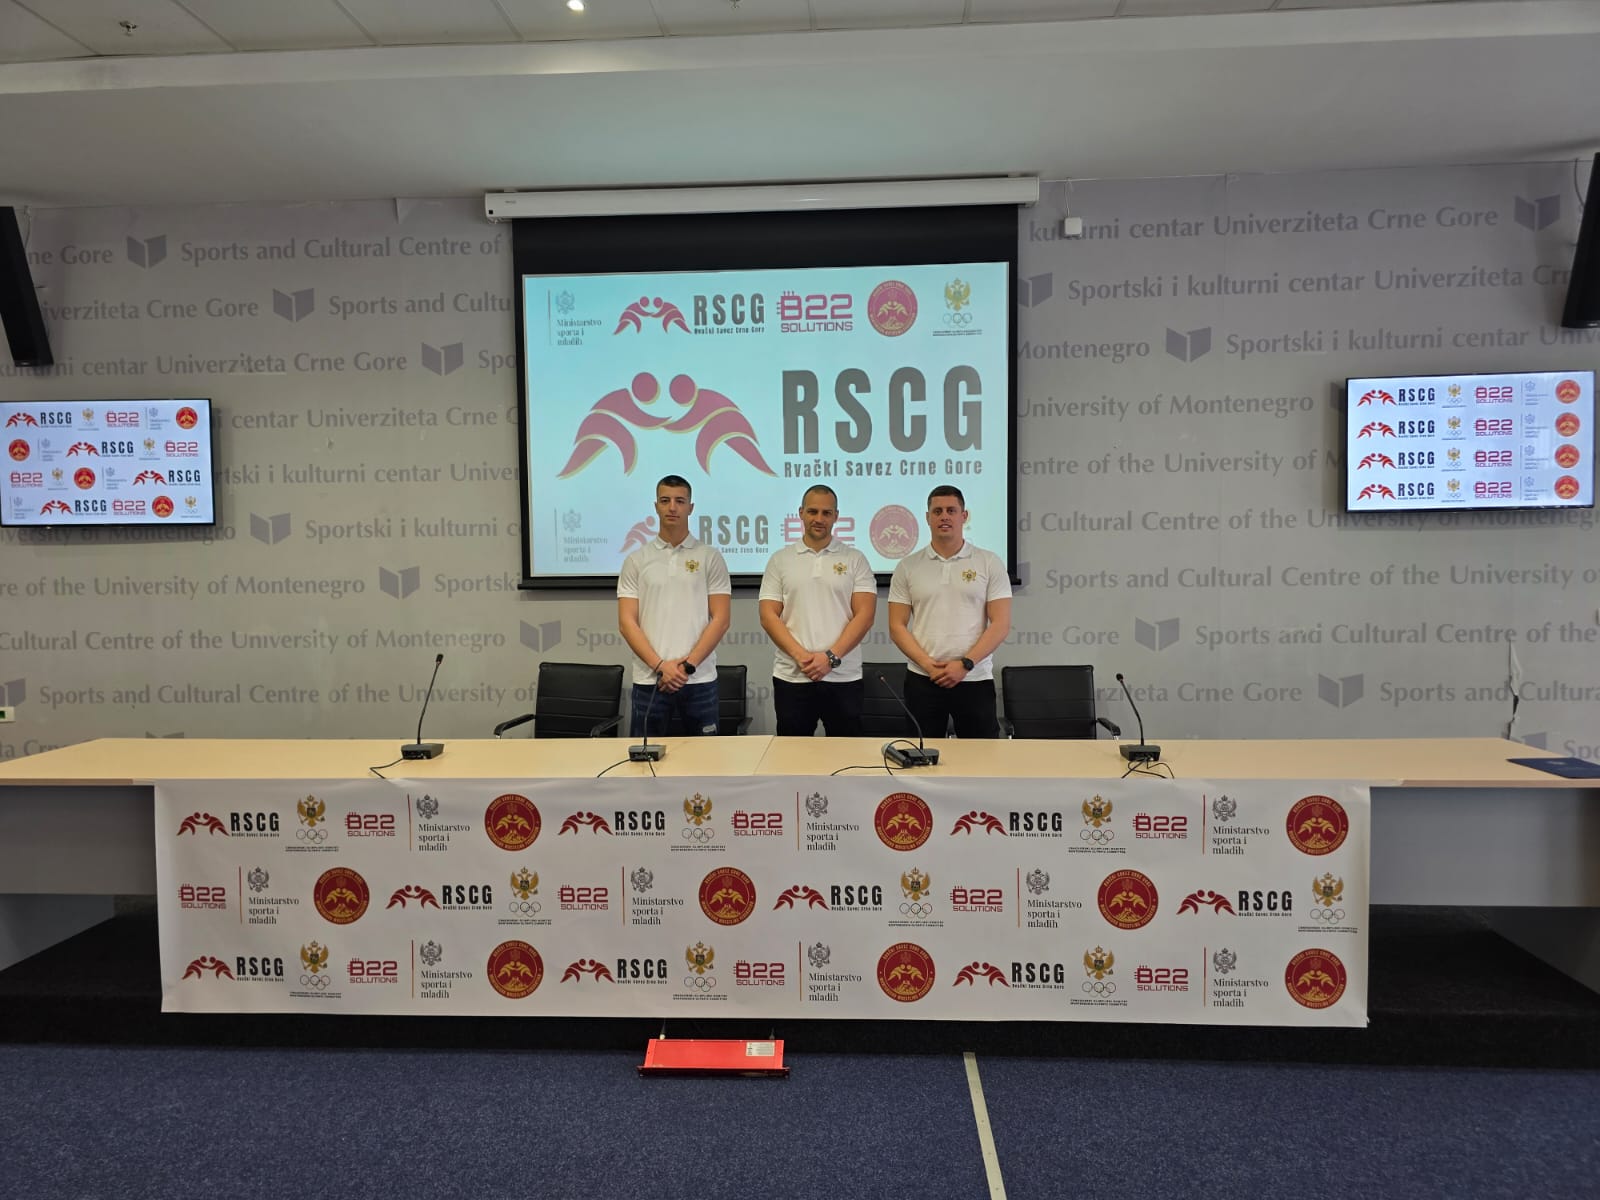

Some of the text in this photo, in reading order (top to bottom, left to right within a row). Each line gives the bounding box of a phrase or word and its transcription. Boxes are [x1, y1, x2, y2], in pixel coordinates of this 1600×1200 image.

[1129, 206, 1498, 238] centar Univerziteta Crne Gore
[61, 244, 114, 265] Gore
[181, 233, 501, 268] Sports and Cultural Centre of
[1068, 266, 1524, 306] Sportski i kulturni centar Univerziteta
[146, 298, 259, 320] Crne Gore
[328, 292, 444, 321] Sports and
[694, 293, 764, 327] RSCG
[778, 291, 853, 321] B22
[781, 321, 853, 333] SOLUTIONS
[1226, 330, 1322, 360] Sportski
[1332, 329, 1339, 351] i
[1348, 327, 1443, 351] kulturni
[1452, 328, 1529, 347] centar
[82, 351, 407, 376] centar Univerziteta Crne Gore
[1399, 388, 1436, 402] RSCG
[1474, 385, 1513, 399] B22
[782, 365, 983, 455] RSCG
[1137, 394, 1161, 416] of
[1168, 394, 1314, 419] Montenegro
[40, 411, 73, 425] RSCG
[105, 411, 140, 424] B22
[232, 406, 498, 429] centar Univerziteta Crne
[1398, 419, 1436, 435] RSCG
[101, 441, 135, 455] RSCG
[1087, 449, 1318, 477] of the University of
[1398, 451, 1436, 466] RSCG
[268, 464, 274, 484] i
[283, 463, 365, 485] kulturni
[374, 461, 441, 483] centar
[785, 457, 983, 478] Rvački Savez Crne Gore
[10, 471, 44, 484] B22
[168, 469, 201, 483] RSCG
[1397, 482, 1435, 497] RSCG
[1473, 480, 1513, 494] B22
[74, 500, 107, 513] RSCG
[1040, 508, 1297, 532] Cultural Centre of the
[305, 517, 498, 544] Sportski i kulturni
[698, 514, 769, 547] RSCG
[1045, 563, 1574, 595] Sports and Cultural Centre of the University
[25, 576, 47, 597] of
[53, 577, 85, 596] the
[94, 576, 200, 601] University
[208, 575, 229, 595] of
[235, 574, 366, 598] Montenegro
[86, 631, 155, 650] Centre
[162, 629, 184, 650] of
[190, 629, 223, 649] the
[232, 628, 338, 654] University
[347, 627, 370, 649] of
[376, 628, 506, 654] Montenegro
[1062, 625, 1120, 646] Gore
[1195, 621, 1598, 651] Sports and Cultural Centre of the
[40, 681, 537, 710] Sports and Cultural Centre of the University of
[1177, 681, 1303, 702] Crne Gore
[1380, 681, 1456, 708] Sports
[229, 811, 280, 832] RSCG
[345, 812, 396, 830] B22
[615, 810, 666, 831] RSCG
[731, 810, 783, 829] B22
[806, 822, 859, 831] Ministarstvo
[1009, 811, 1063, 832] RSCG
[1133, 813, 1188, 832] B22
[418, 823, 470, 832] Ministarstvo
[733, 829, 783, 837] SOLUTIONS
[1212, 826, 1270, 835] Ministarstvo
[418, 833, 444, 842] sporta
[806, 833, 833, 842] sporta
[1212, 836, 1242, 845] sporta
[418, 843, 447, 851] mladih
[806, 842, 836, 851] mladih
[1212, 846, 1244, 855] mladih
[179, 884, 226, 902] B22
[442, 884, 493, 905] RSCG
[558, 885, 609, 903] B22
[830, 884, 883, 906] RSCG
[951, 887, 1003, 905] B22
[1238, 889, 1293, 912] RSCG
[181, 902, 226, 910] SOLUTIONS
[248, 896, 300, 906] Ministarstvo
[560, 903, 609, 911] SOLUTIONS
[632, 897, 684, 906] Ministarstvo
[1027, 899, 1082, 909] Ministarstvo
[248, 906, 275, 916] sporta
[632, 907, 659, 917] sporta
[952, 905, 1003, 913] SOLUTIONS
[1027, 909, 1055, 919] sporta
[248, 916, 277, 925] mladih
[632, 916, 661, 926] mladih
[1027, 919, 1058, 929] mladih
[236, 956, 284, 977] RSCG
[347, 958, 398, 977] B22
[616, 958, 668, 979] RSCG
[733, 960, 785, 979] B22
[1011, 961, 1065, 984] RSCG
[349, 976, 398, 984] SOLUTIONS
[421, 970, 473, 980] Ministarstvo
[808, 972, 862, 983] Ministarstvo
[1134, 965, 1189, 985] B22
[421, 981, 448, 990] sporta
[735, 979, 785, 987] SOLUTIONS
[808, 983, 836, 992] sporta
[1136, 984, 1189, 992] SOLUTIONS
[1213, 978, 1269, 988] Ministarstvo
[421, 990, 450, 999] mladih
[808, 992, 839, 1002] mladih
[1213, 989, 1242, 999] sporta
[1213, 998, 1245, 1008] mladih
